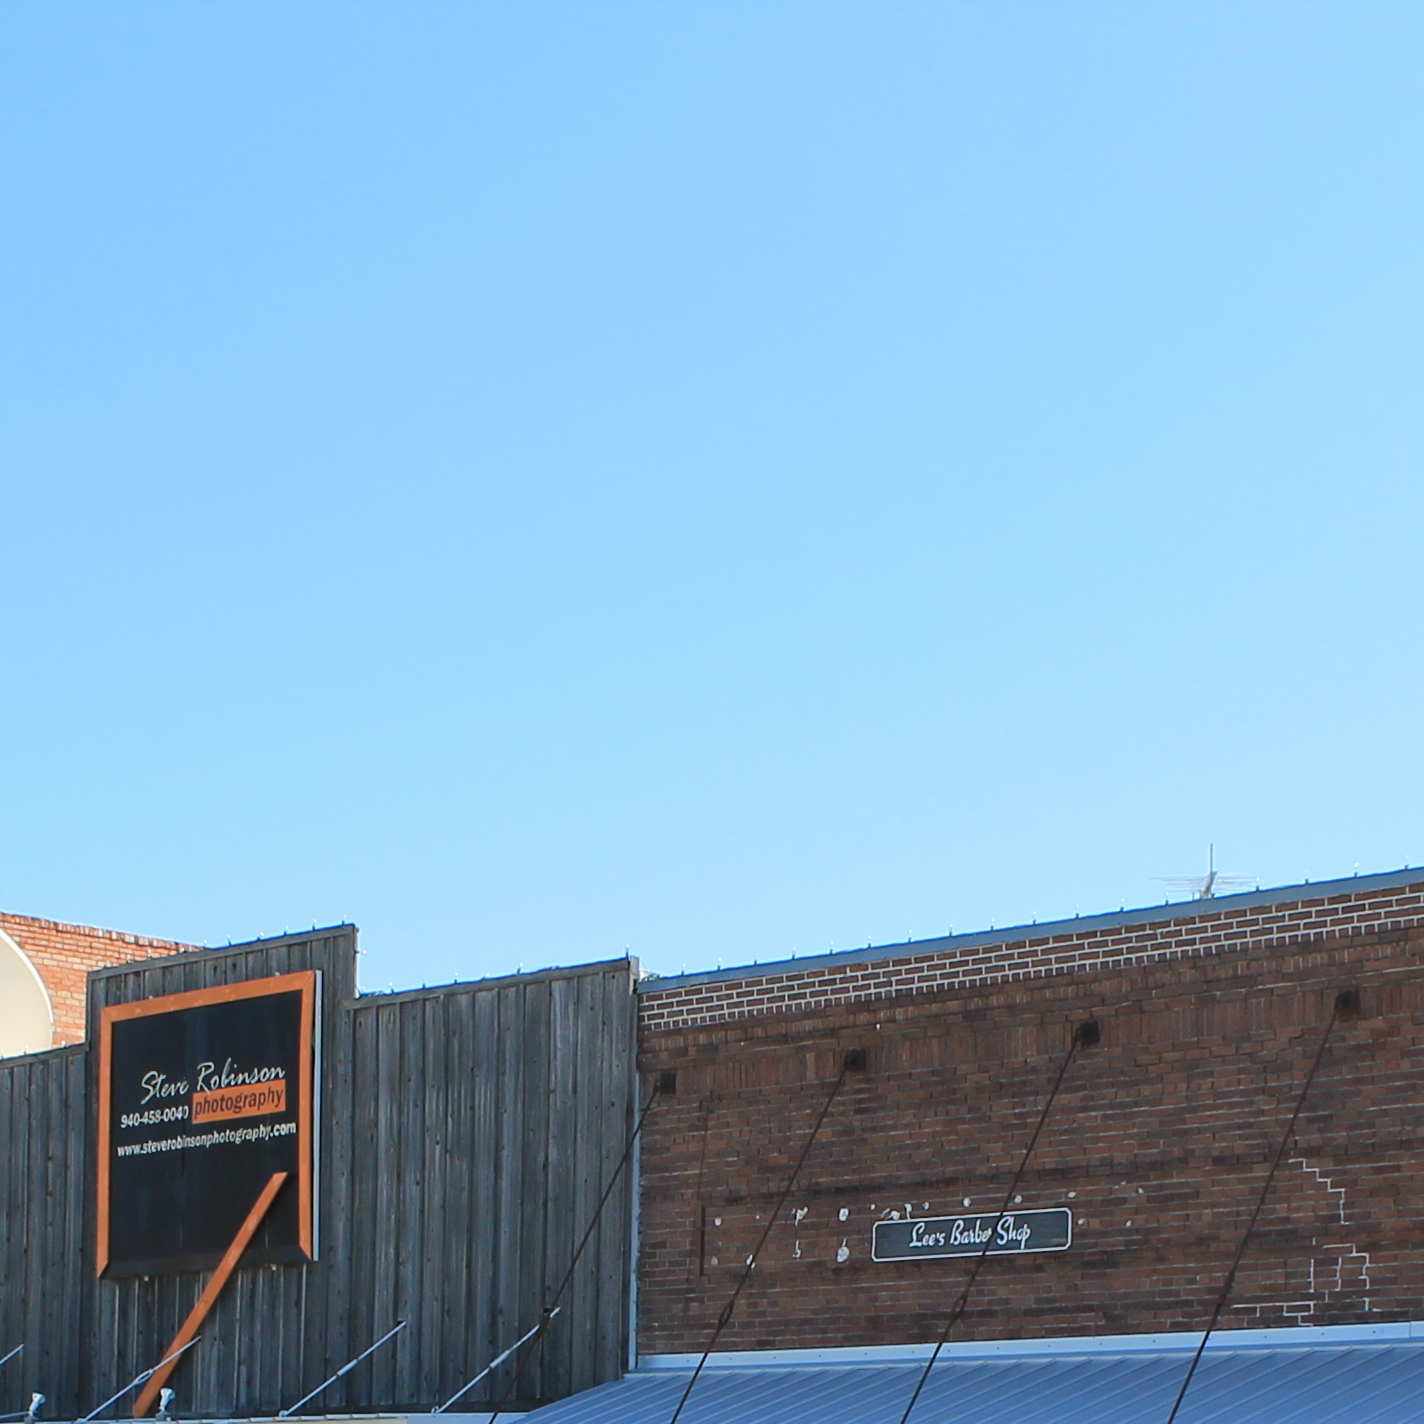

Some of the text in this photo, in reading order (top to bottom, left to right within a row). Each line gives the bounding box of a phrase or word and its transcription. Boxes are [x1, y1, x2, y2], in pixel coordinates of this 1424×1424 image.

[141, 1057, 286, 1105] Steve Robinson
[120, 1105, 189, 1128] 940-458-0040
[193, 1087, 284, 1120] photography
[117, 1122, 297, 1157] www.steverobinsonphotography.com
[909, 1222, 946, 1248] Lee's
[996, 1216, 1031, 1250] Shop
